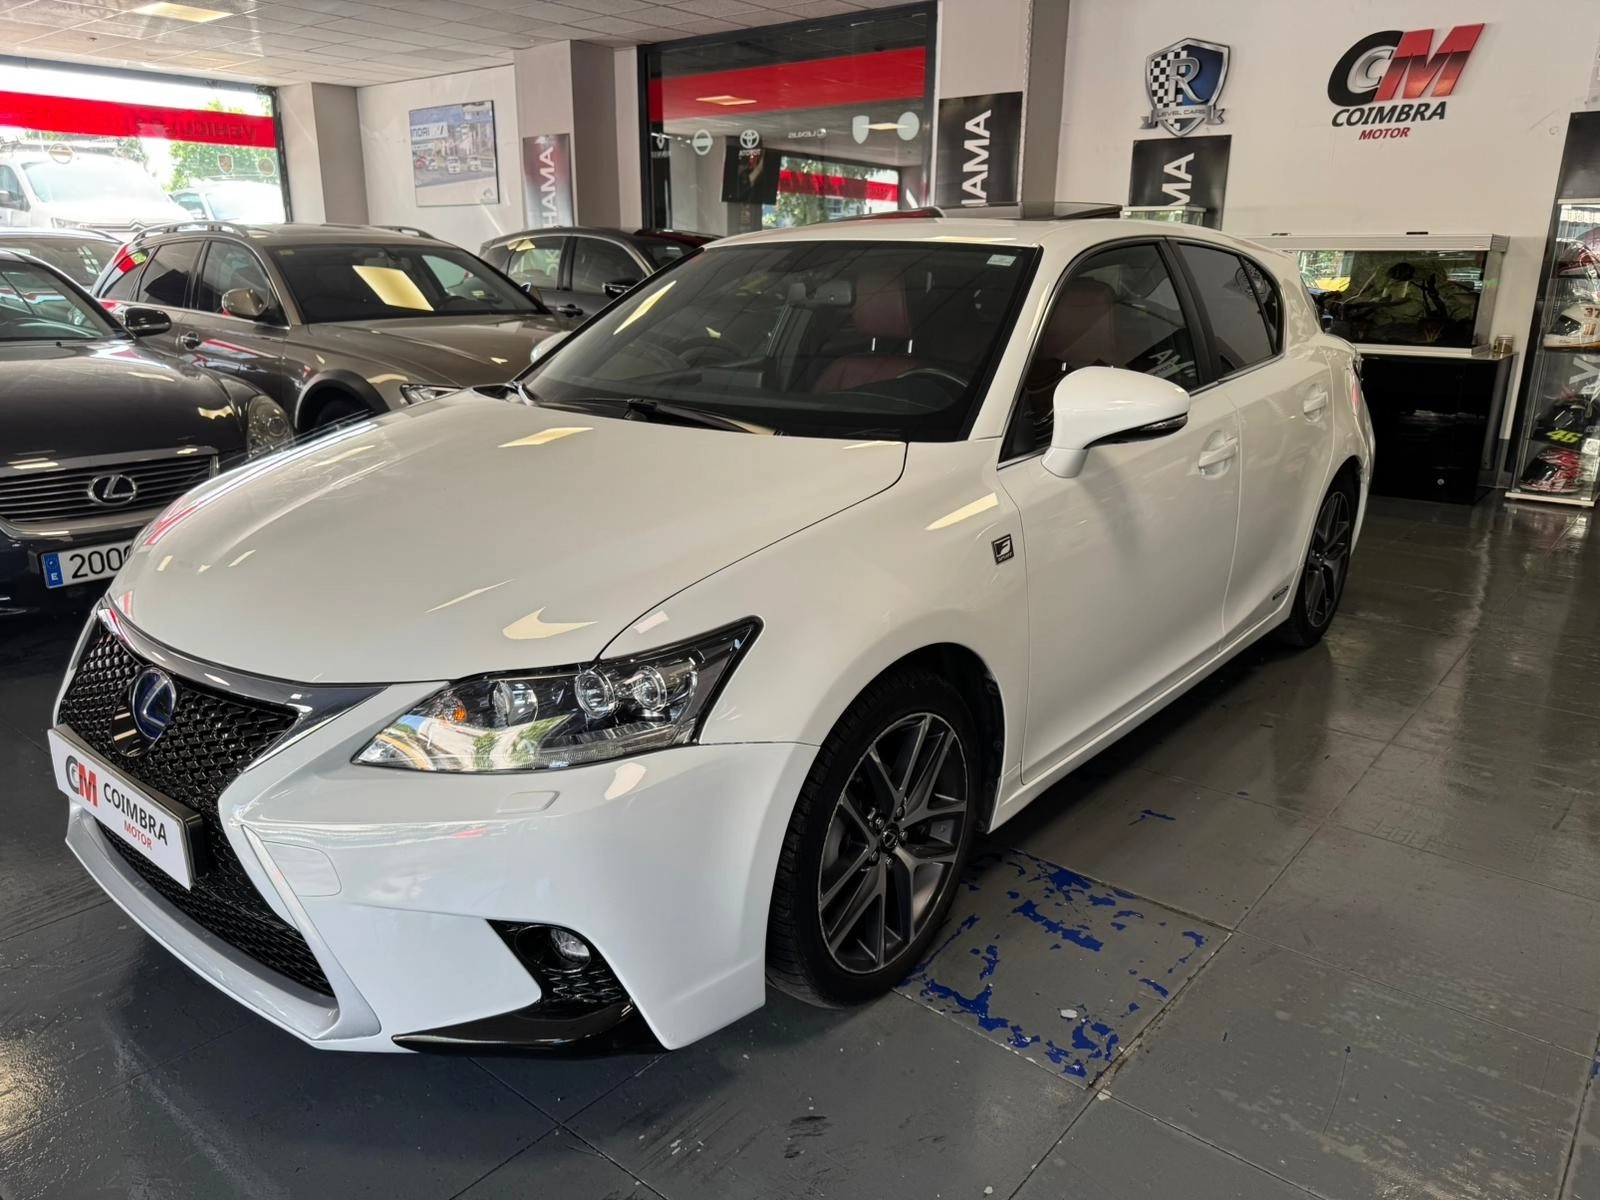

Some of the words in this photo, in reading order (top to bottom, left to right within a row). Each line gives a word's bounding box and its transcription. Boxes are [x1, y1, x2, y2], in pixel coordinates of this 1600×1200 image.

[1332, 101, 1447, 127] COIMBRA
[1358, 127, 1411, 141] MOTOR
[1546, 429, 1583, 443] 46
[69, 545, 130, 579] 200
[65, 755, 98, 808] CM
[103, 782, 168, 846] COIMBRA
[124, 820, 153, 852] MOTOR
